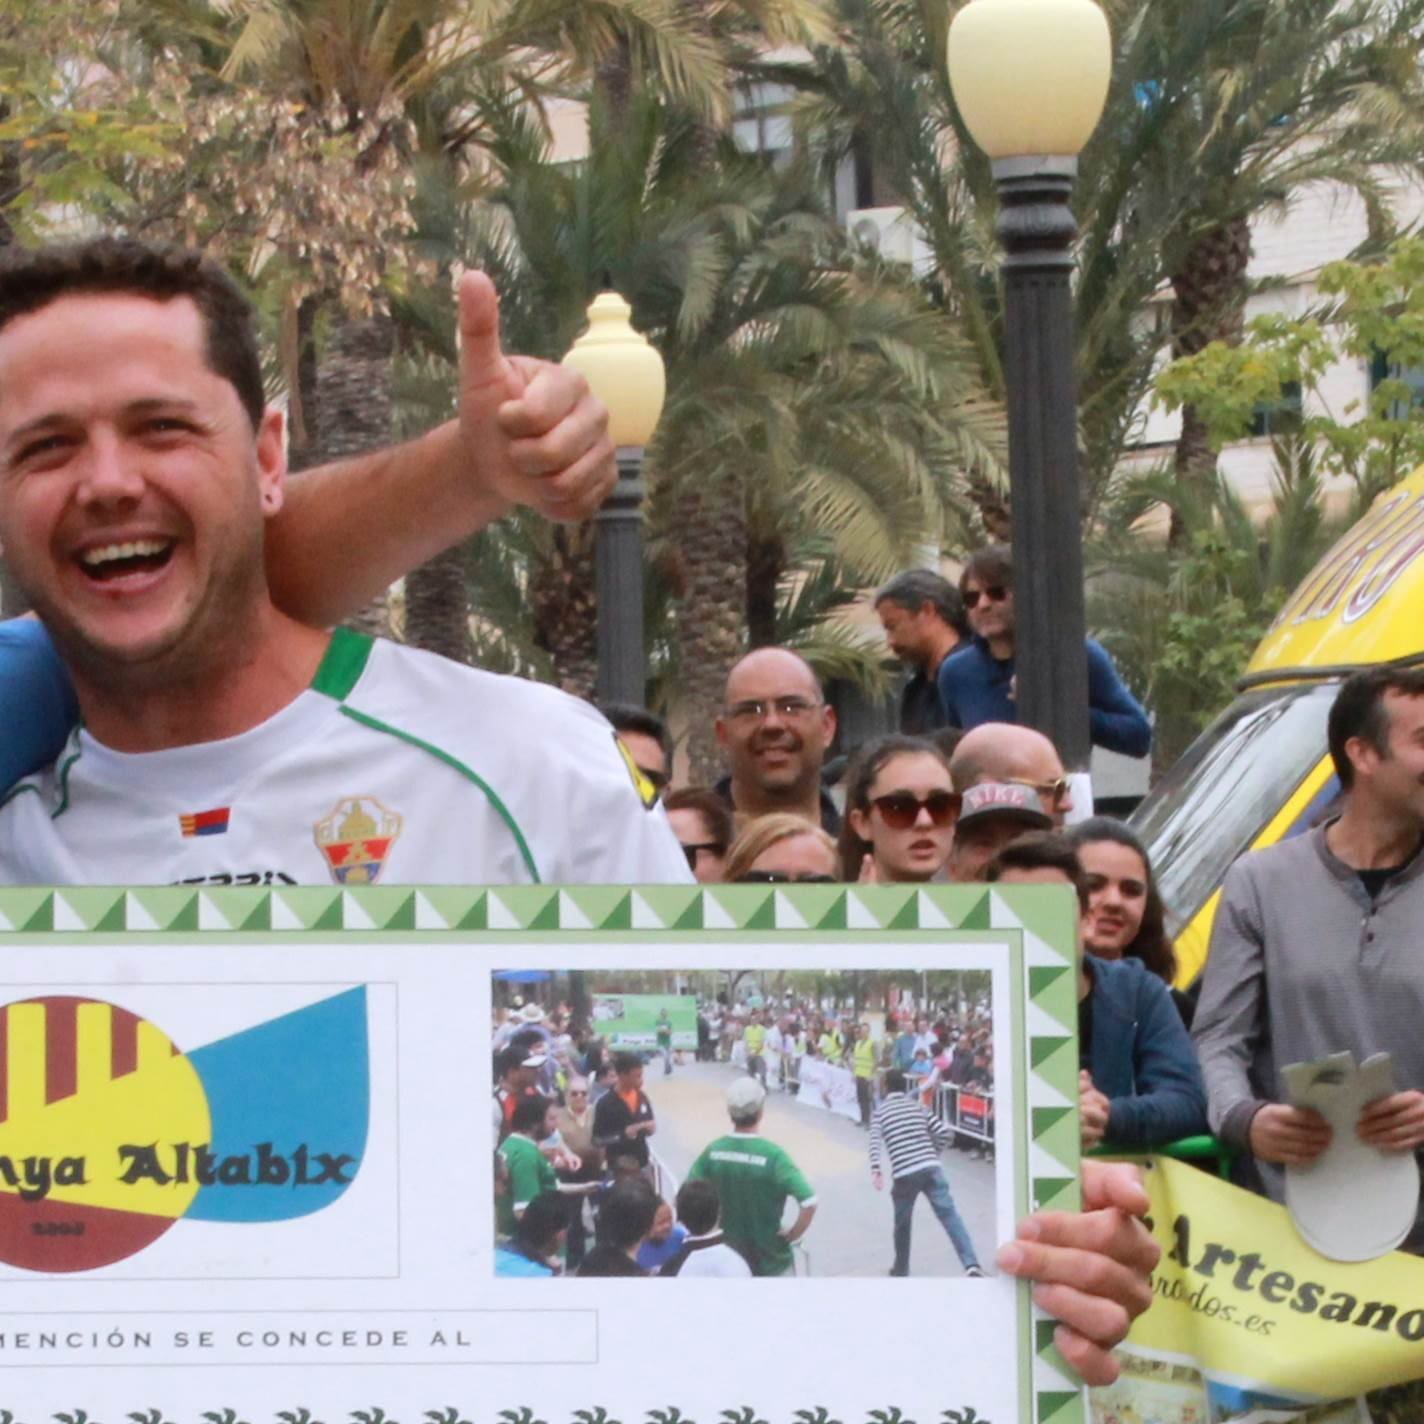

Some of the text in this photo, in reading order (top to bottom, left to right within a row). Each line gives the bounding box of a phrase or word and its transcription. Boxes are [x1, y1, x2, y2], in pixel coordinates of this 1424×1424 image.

[117, 1138, 359, 1189] Altabix
[173, 1331, 216, 1349] SE
[236, 1330, 409, 1349] CONCEDE
[429, 1330, 474, 1348] AL
